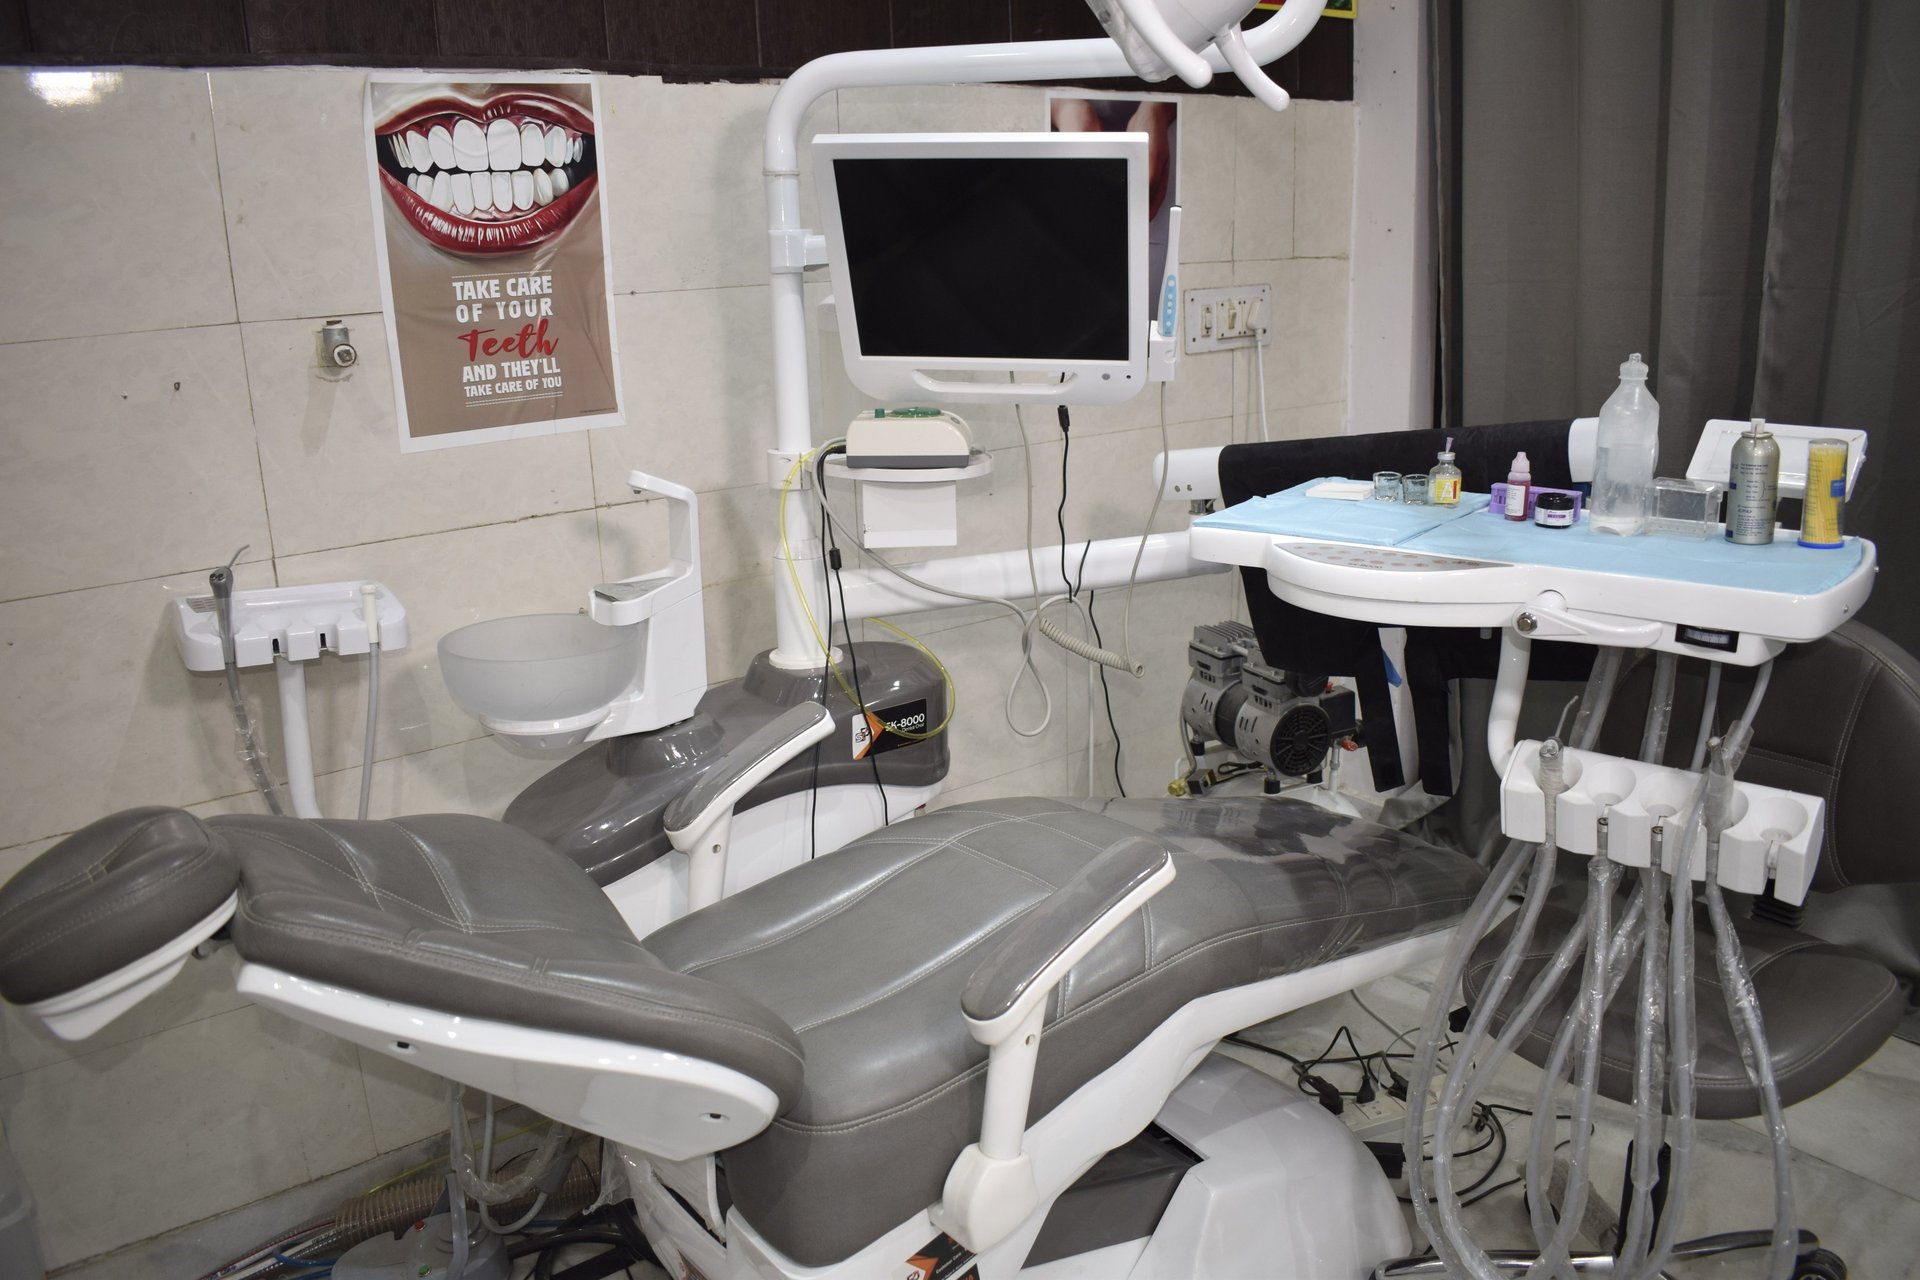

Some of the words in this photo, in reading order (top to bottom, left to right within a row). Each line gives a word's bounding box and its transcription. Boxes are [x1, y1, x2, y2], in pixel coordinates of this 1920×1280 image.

[452, 279, 501, 301] TAKE
[506, 275, 553, 297] CARE
[456, 303, 483, 323] OF
[496, 297, 553, 320] YOUR
[457, 318, 559, 362] Teeth
[463, 363, 497, 383] AND
[501, 357, 561, 379] THEY'LL
[464, 383, 493, 398] TAKE
[495, 380, 523, 394] CARE
[526, 378, 539, 391] OF
[542, 376, 562, 389] YOU
